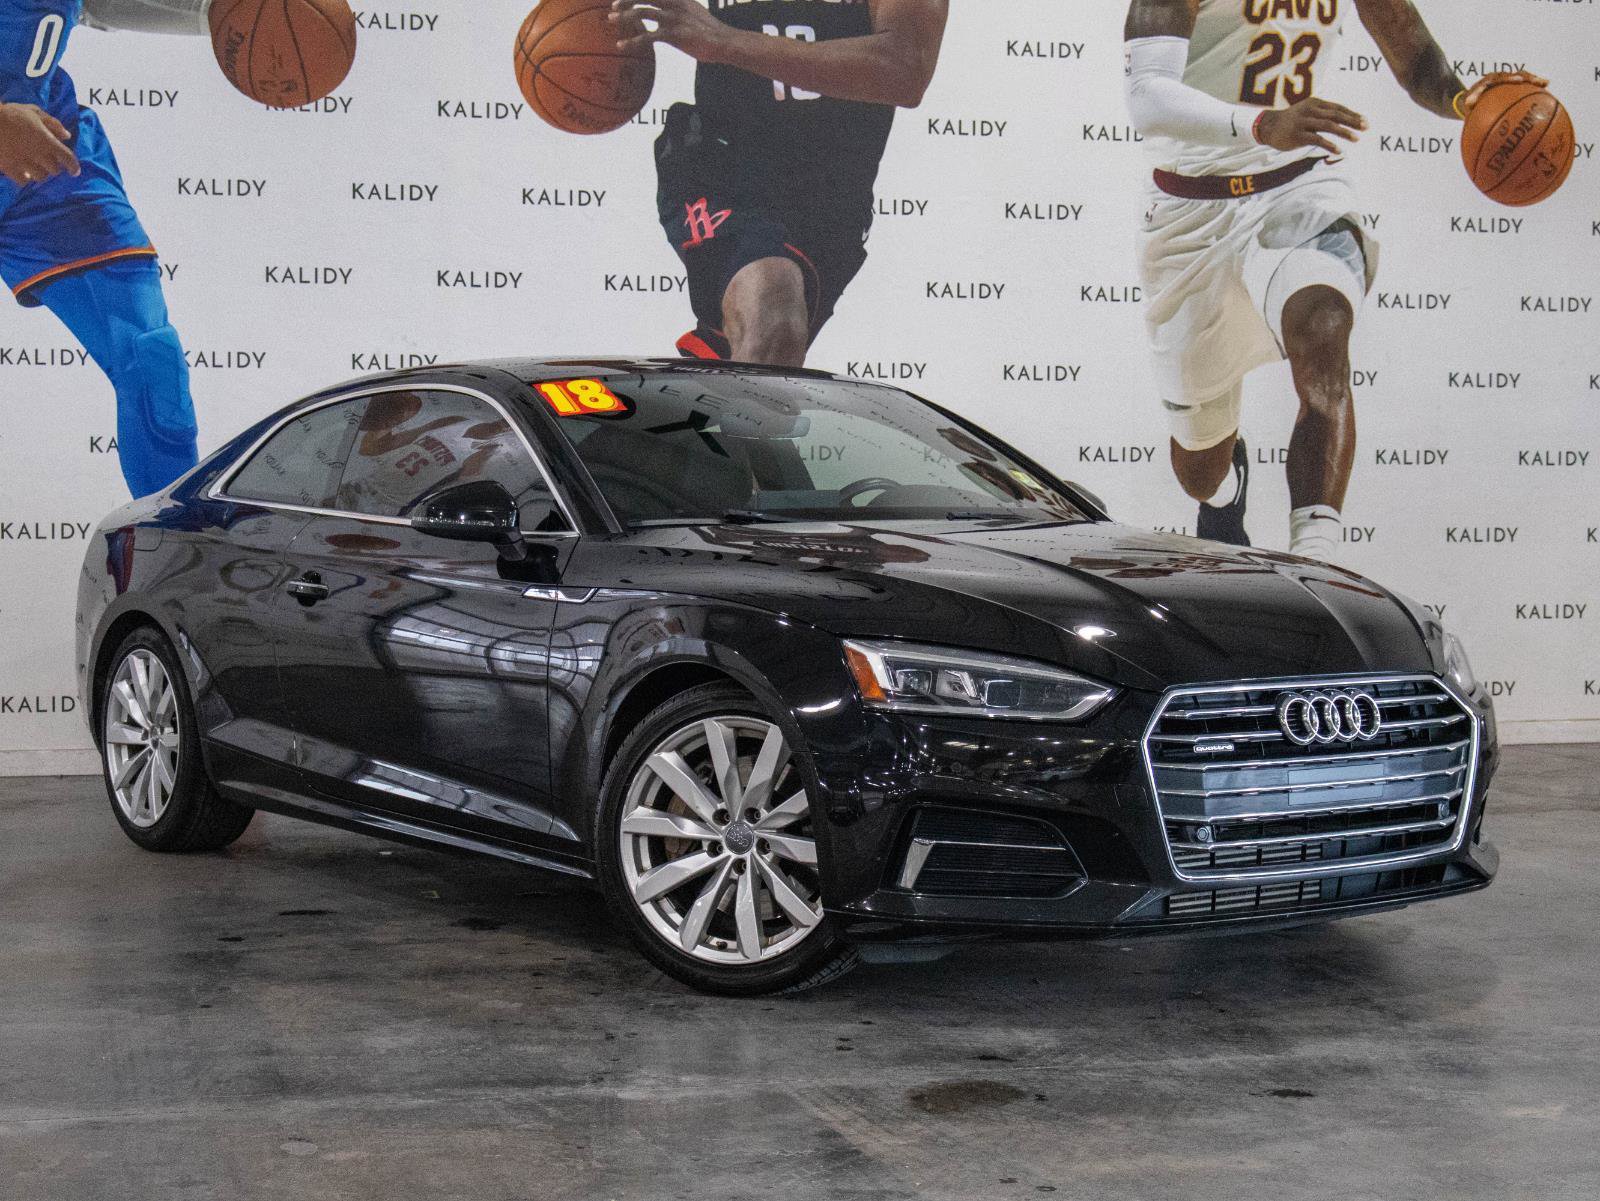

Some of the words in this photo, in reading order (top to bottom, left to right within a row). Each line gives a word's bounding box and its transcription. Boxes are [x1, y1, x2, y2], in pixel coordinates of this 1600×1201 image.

[354, 12, 438, 31] KALIDY
[25, 14, 64, 78] 0
[1006, 40, 1084, 59] KALIDY
[1240, 32, 1322, 107] 23
[90, 88, 178, 107] KALIDY
[438, 100, 523, 120] KALIDY
[928, 118, 1007, 137] KALIDY
[1380, 135, 1454, 153] KALIDY
[178, 177, 266, 197] KALIDY
[352, 183, 438, 202] KALIDY
[1229, 176, 1255, 196] CLE
[522, 188, 606, 207] KALIDY
[1004, 202, 1083, 220] KALIDY
[1451, 216, 1523, 233] KALIDY
[266, 266, 352, 284] KALIDY
[437, 270, 523, 288] KALIDY
[605, 274, 687, 292] KALIDY
[927, 281, 1005, 299] KALIDY
[1378, 293, 1451, 309] KALIDY
[1521, 296, 1592, 312] KALIDY
[0, 348, 88, 366] KALIDY
[848, 362, 926, 379] KALIDY
[1004, 365, 1081, 382] KALIDY
[1449, 372, 1520, 388] KALIDY
[540, 379, 619, 414] 18
[1079, 446, 1155, 463] KALIDY
[1376, 449, 1448, 465] KALIDY
[1519, 451, 1589, 467] KALIDY
[1, 522, 90, 540] KALIDY
[1447, 527, 1518, 543] KALIDY
[1516, 604, 1586, 619] KALIDY
[2, 696, 76, 714] KALID
